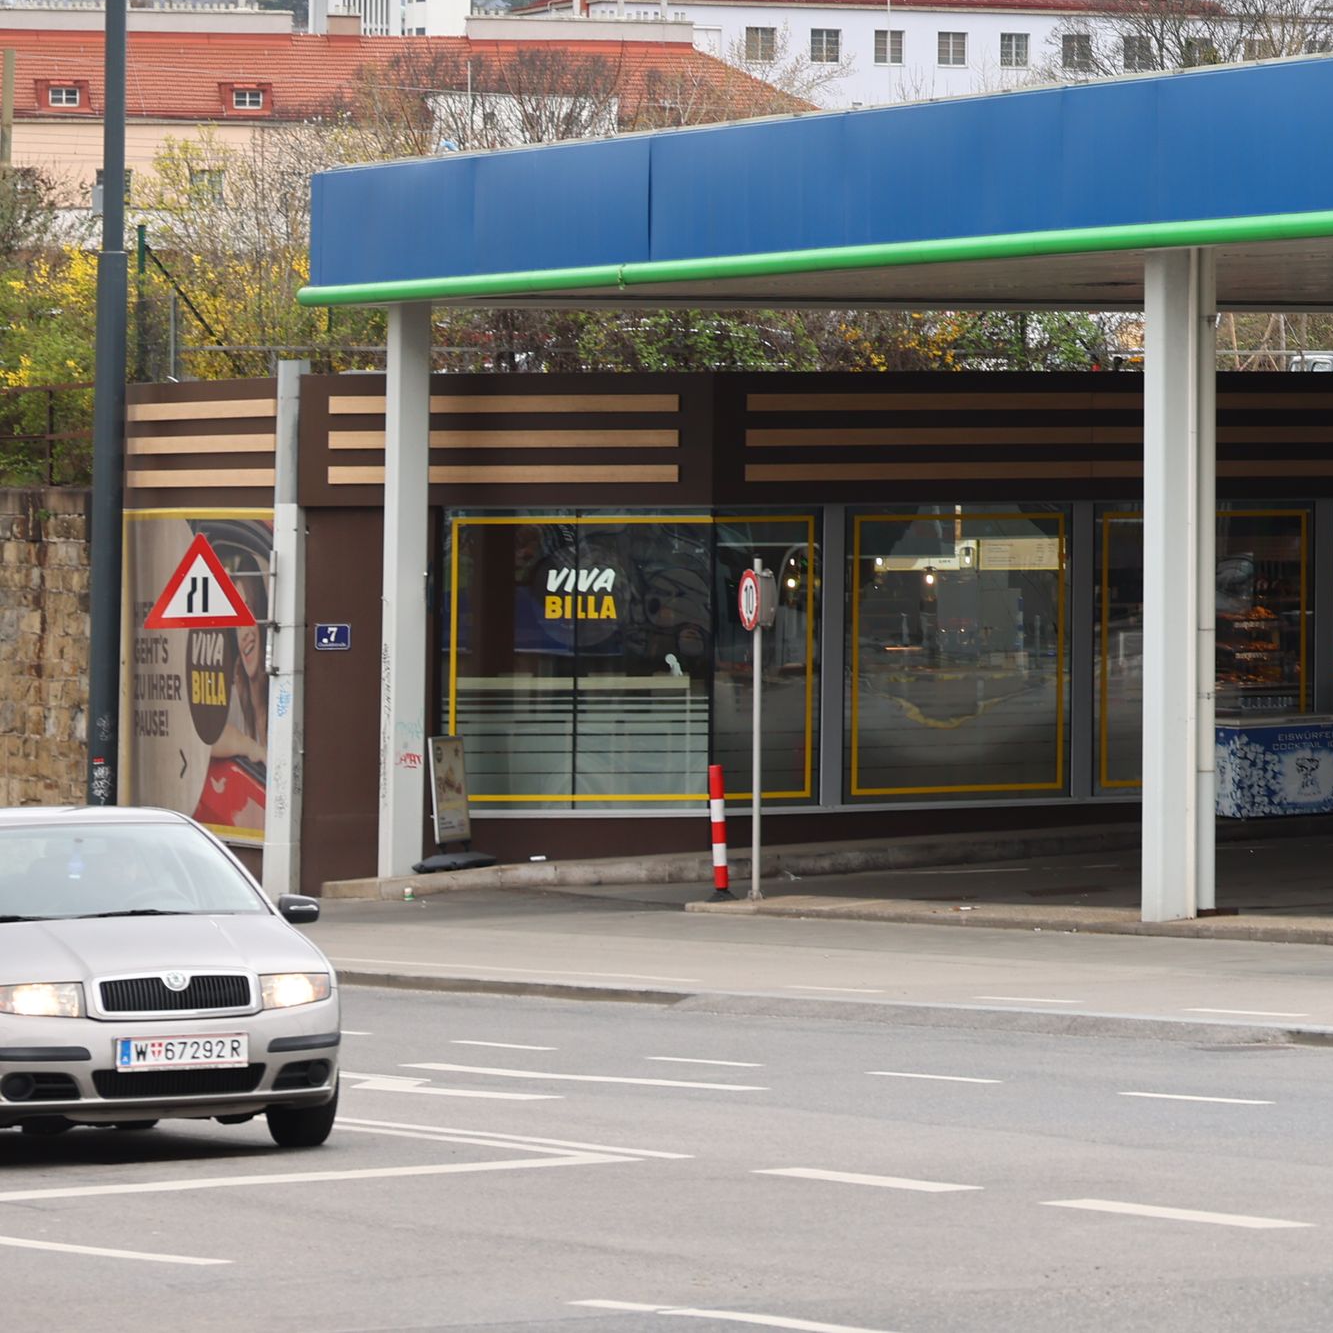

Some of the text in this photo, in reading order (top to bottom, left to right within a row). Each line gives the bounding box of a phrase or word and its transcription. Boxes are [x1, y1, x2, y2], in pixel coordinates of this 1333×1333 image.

[546, 567, 616, 592] VIVA
[544, 595, 617, 619] BILLA
[327, 627, 338, 642] 7
[133, 635, 169, 665] GEHT'S
[192, 632, 225, 666] VIVA
[147, 674, 181, 700] IHRER
[191, 670, 227, 706] BILLA
[133, 709, 169, 737] PAUSE!
[135, 1043, 148, 1062] W
